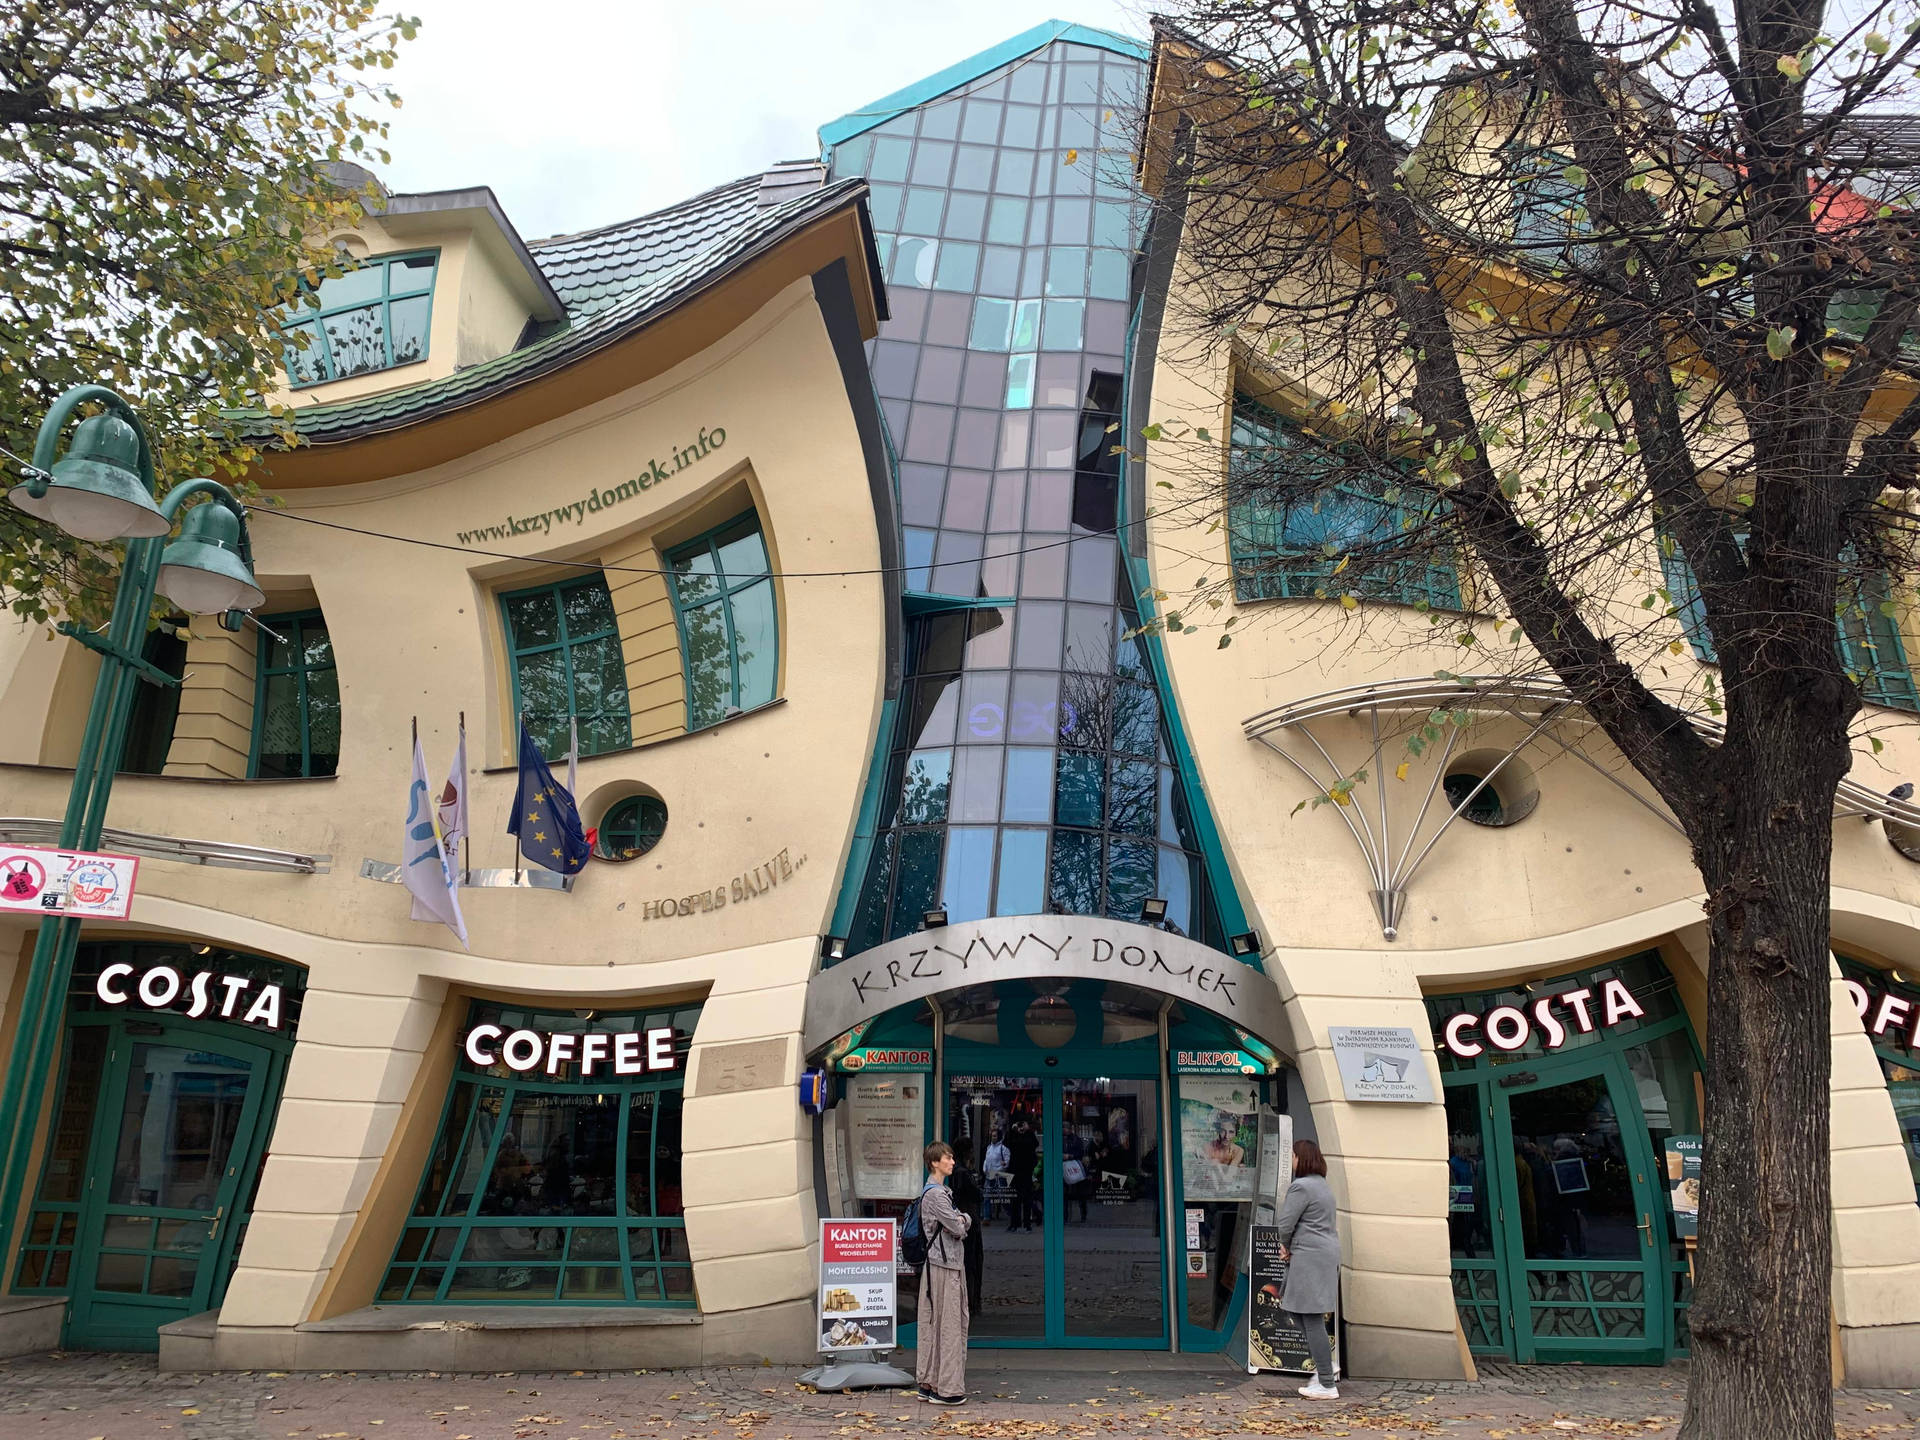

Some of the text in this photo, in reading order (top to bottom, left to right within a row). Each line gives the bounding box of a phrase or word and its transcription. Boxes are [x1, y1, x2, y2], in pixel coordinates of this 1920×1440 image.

[457, 425, 727, 545] www.krzywydomek.info
[66, 858, 116, 872] ZAZ
[643, 886, 726, 921] HOSPES
[851, 934, 1239, 1006] KRZYWY DOMEK
[96, 962, 282, 1029] COSTA
[1444, 976, 1646, 1058] COSTA
[464, 1023, 677, 1076] COFFEE
[866, 1050, 931, 1065] KANTOR
[1177, 1051, 1242, 1067] BLIKPOL
[1354, 1083, 1419, 1091] KRZYWY DOMEK
[830, 1228, 888, 1242] KANTOR
